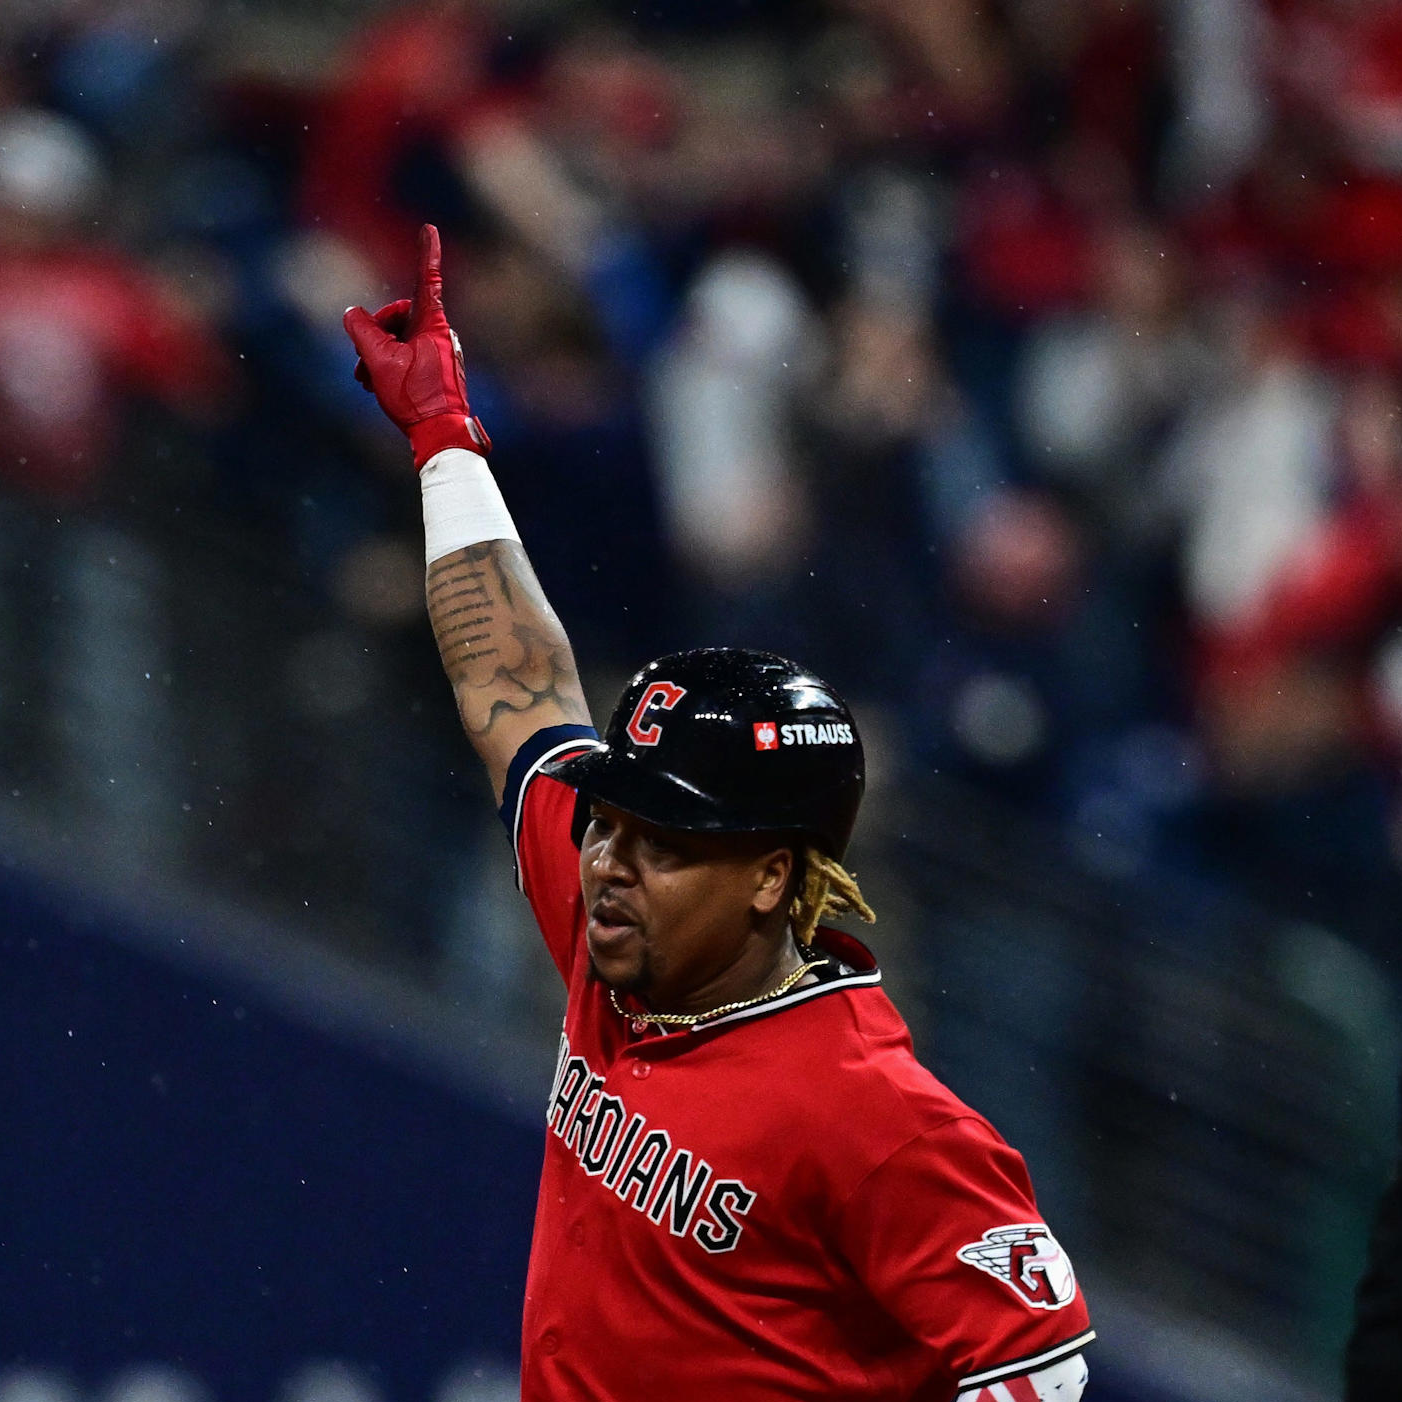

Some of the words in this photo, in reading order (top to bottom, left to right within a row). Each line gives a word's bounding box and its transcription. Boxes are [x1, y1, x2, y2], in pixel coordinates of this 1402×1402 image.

[626, 680, 688, 747] C
[780, 723, 854, 746] STRAUSS
[546, 1030, 758, 1254] ARDIANS
